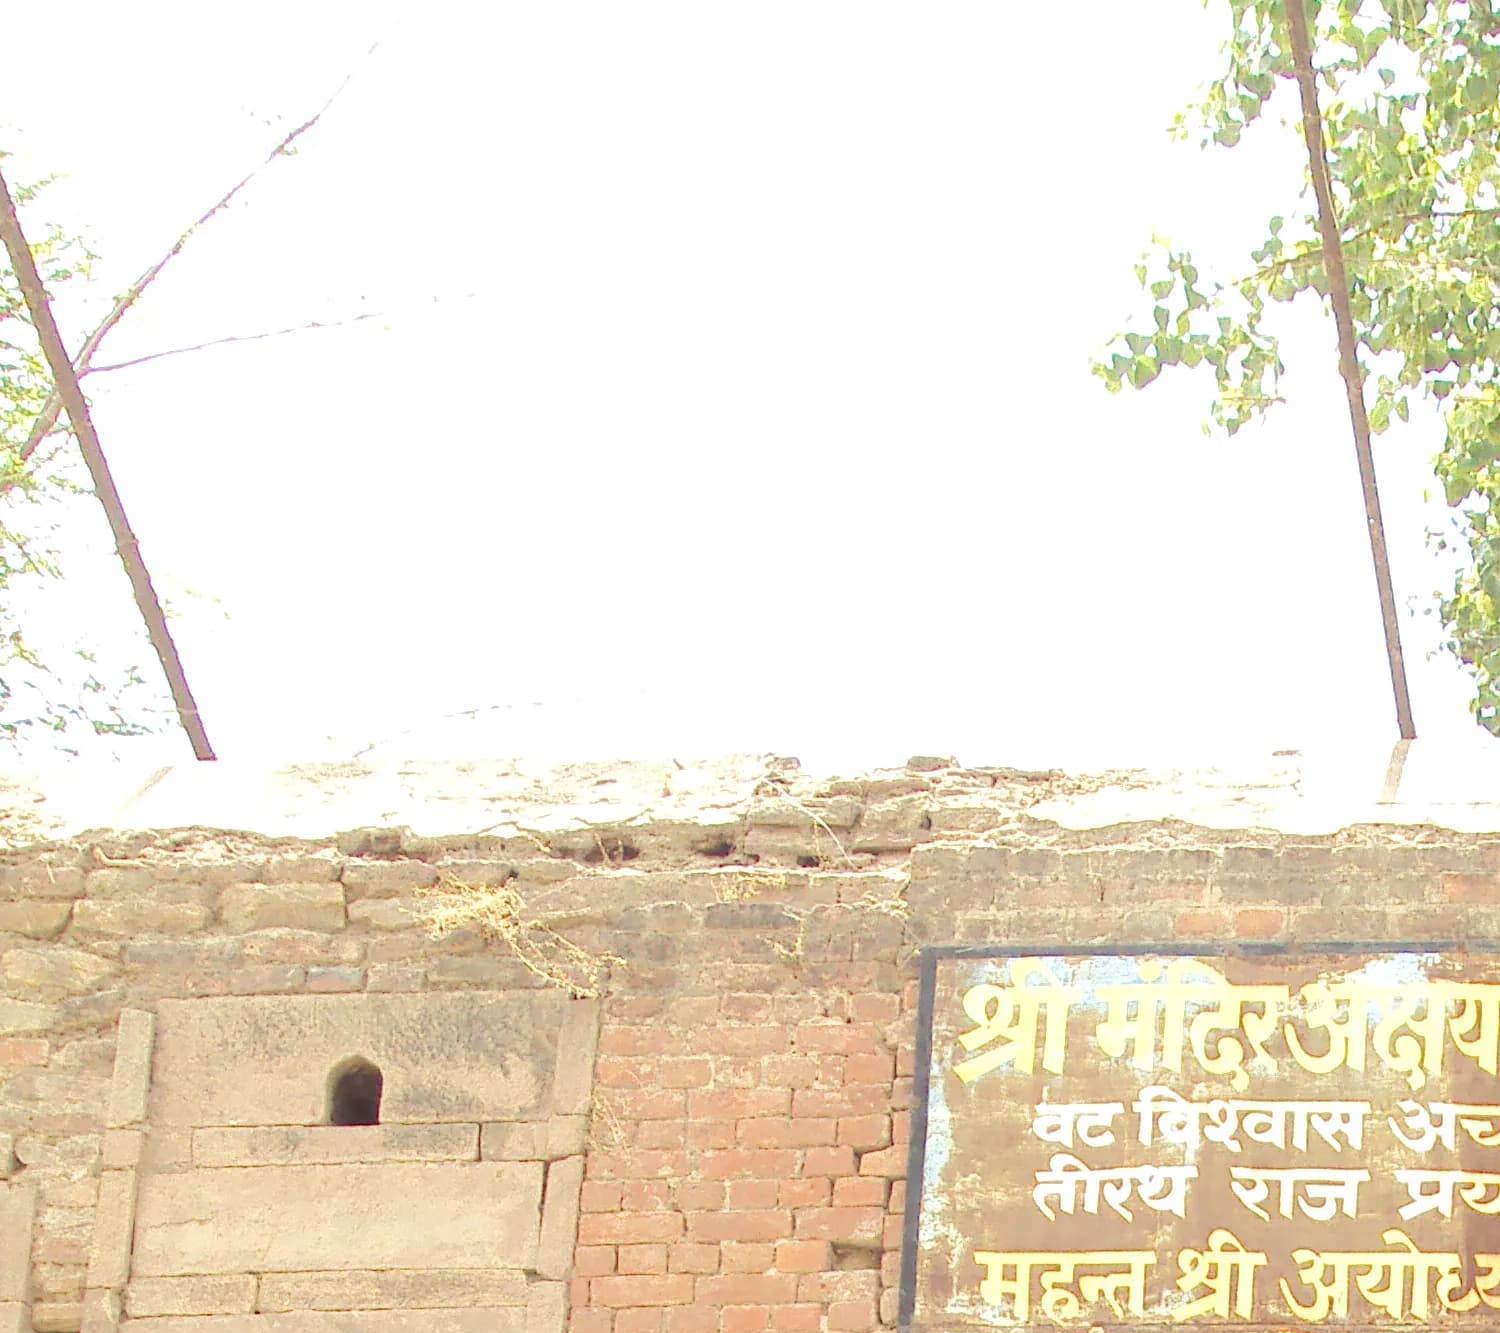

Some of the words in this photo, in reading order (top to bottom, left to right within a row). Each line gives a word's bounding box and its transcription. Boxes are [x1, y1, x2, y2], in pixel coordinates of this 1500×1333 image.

[951, 956, 1073, 1084] श्री
[1032, 1100, 1125, 1147] वट
[1133, 1086, 1370, 1153] विश्वास
[1033, 1153, 1198, 1222] तीरथ
[1231, 1168, 1370, 1221] राज
[975, 1249, 1157, 1321] महन्त
[1173, 1229, 1267, 1321] श्री
